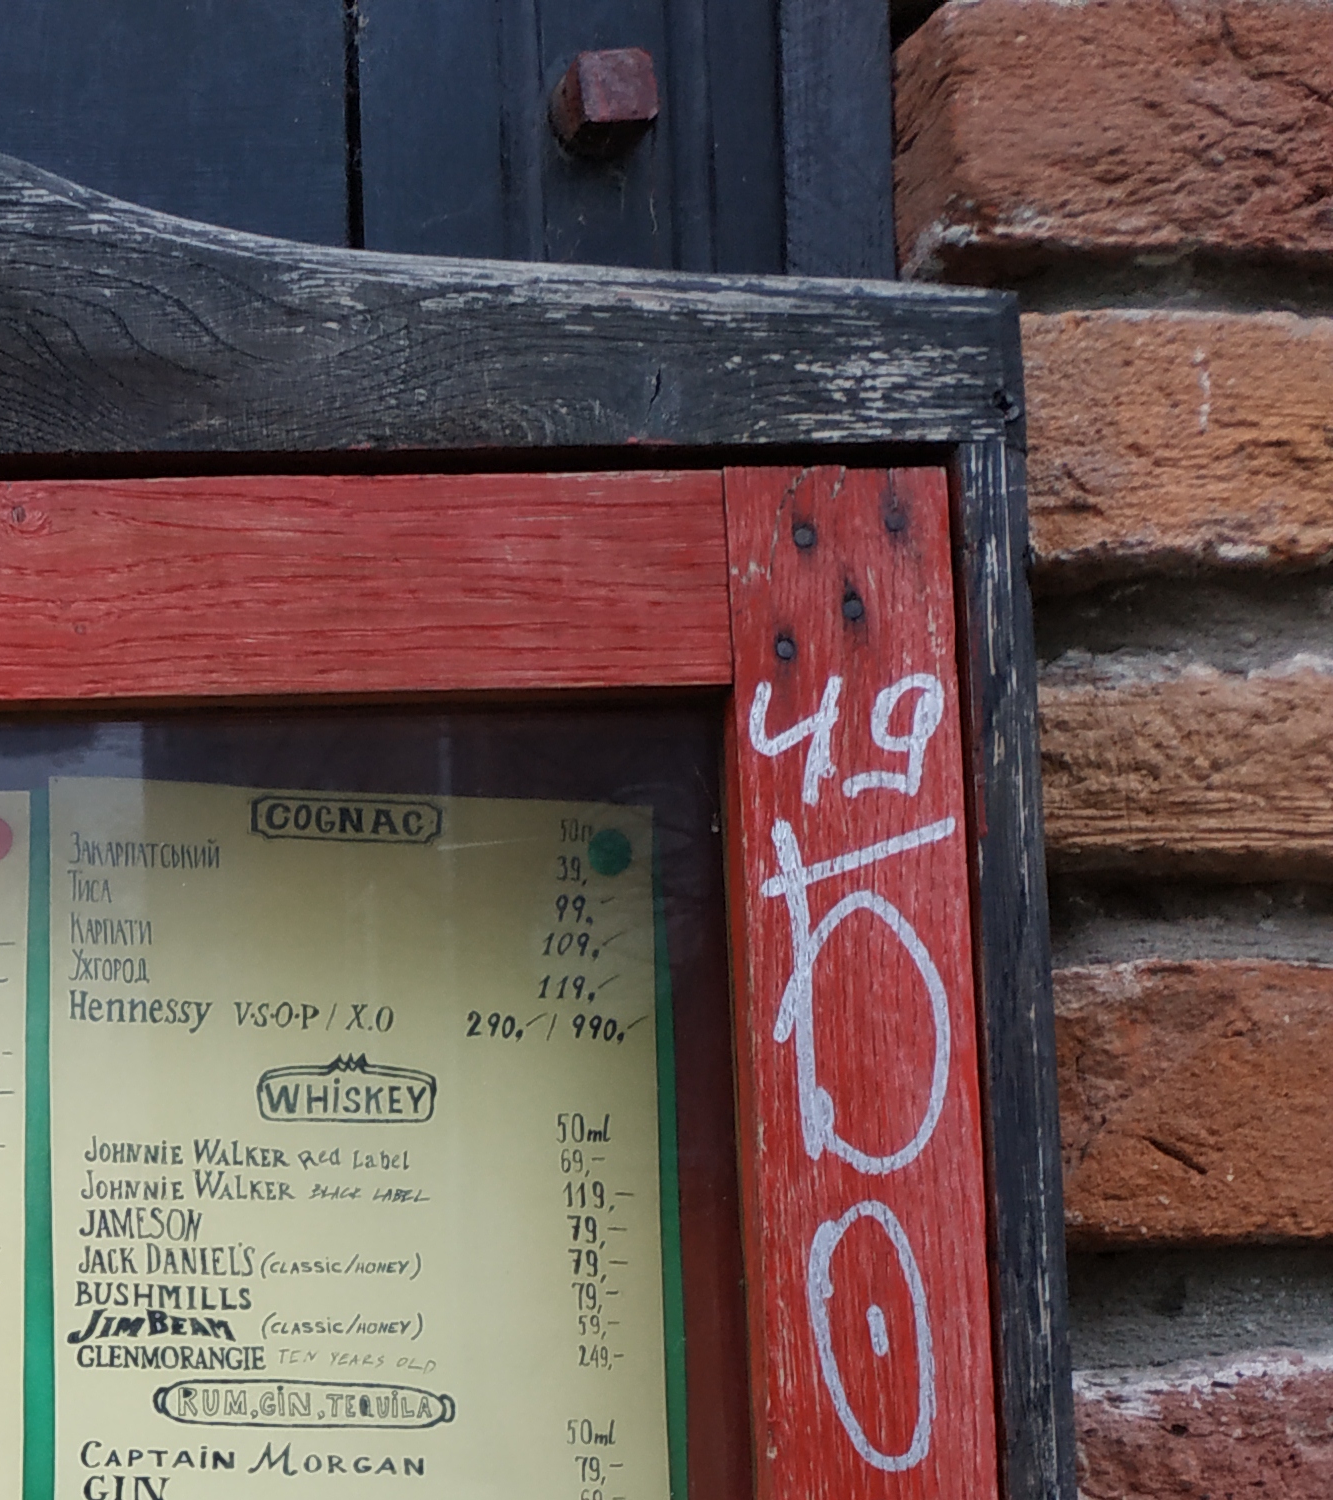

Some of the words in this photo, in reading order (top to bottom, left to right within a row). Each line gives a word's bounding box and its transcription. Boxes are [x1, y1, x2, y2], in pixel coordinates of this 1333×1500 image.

[265, 803, 424, 836] COGNAC
[69, 989, 212, 1034] Hennessy
[79, 1207, 202, 1242] JAMESON
[79, 1245, 138, 1274] JACK
[75, 1281, 251, 1310] BUSHMILLS
[77, 1345, 266, 1371] GLENMORANGIE
